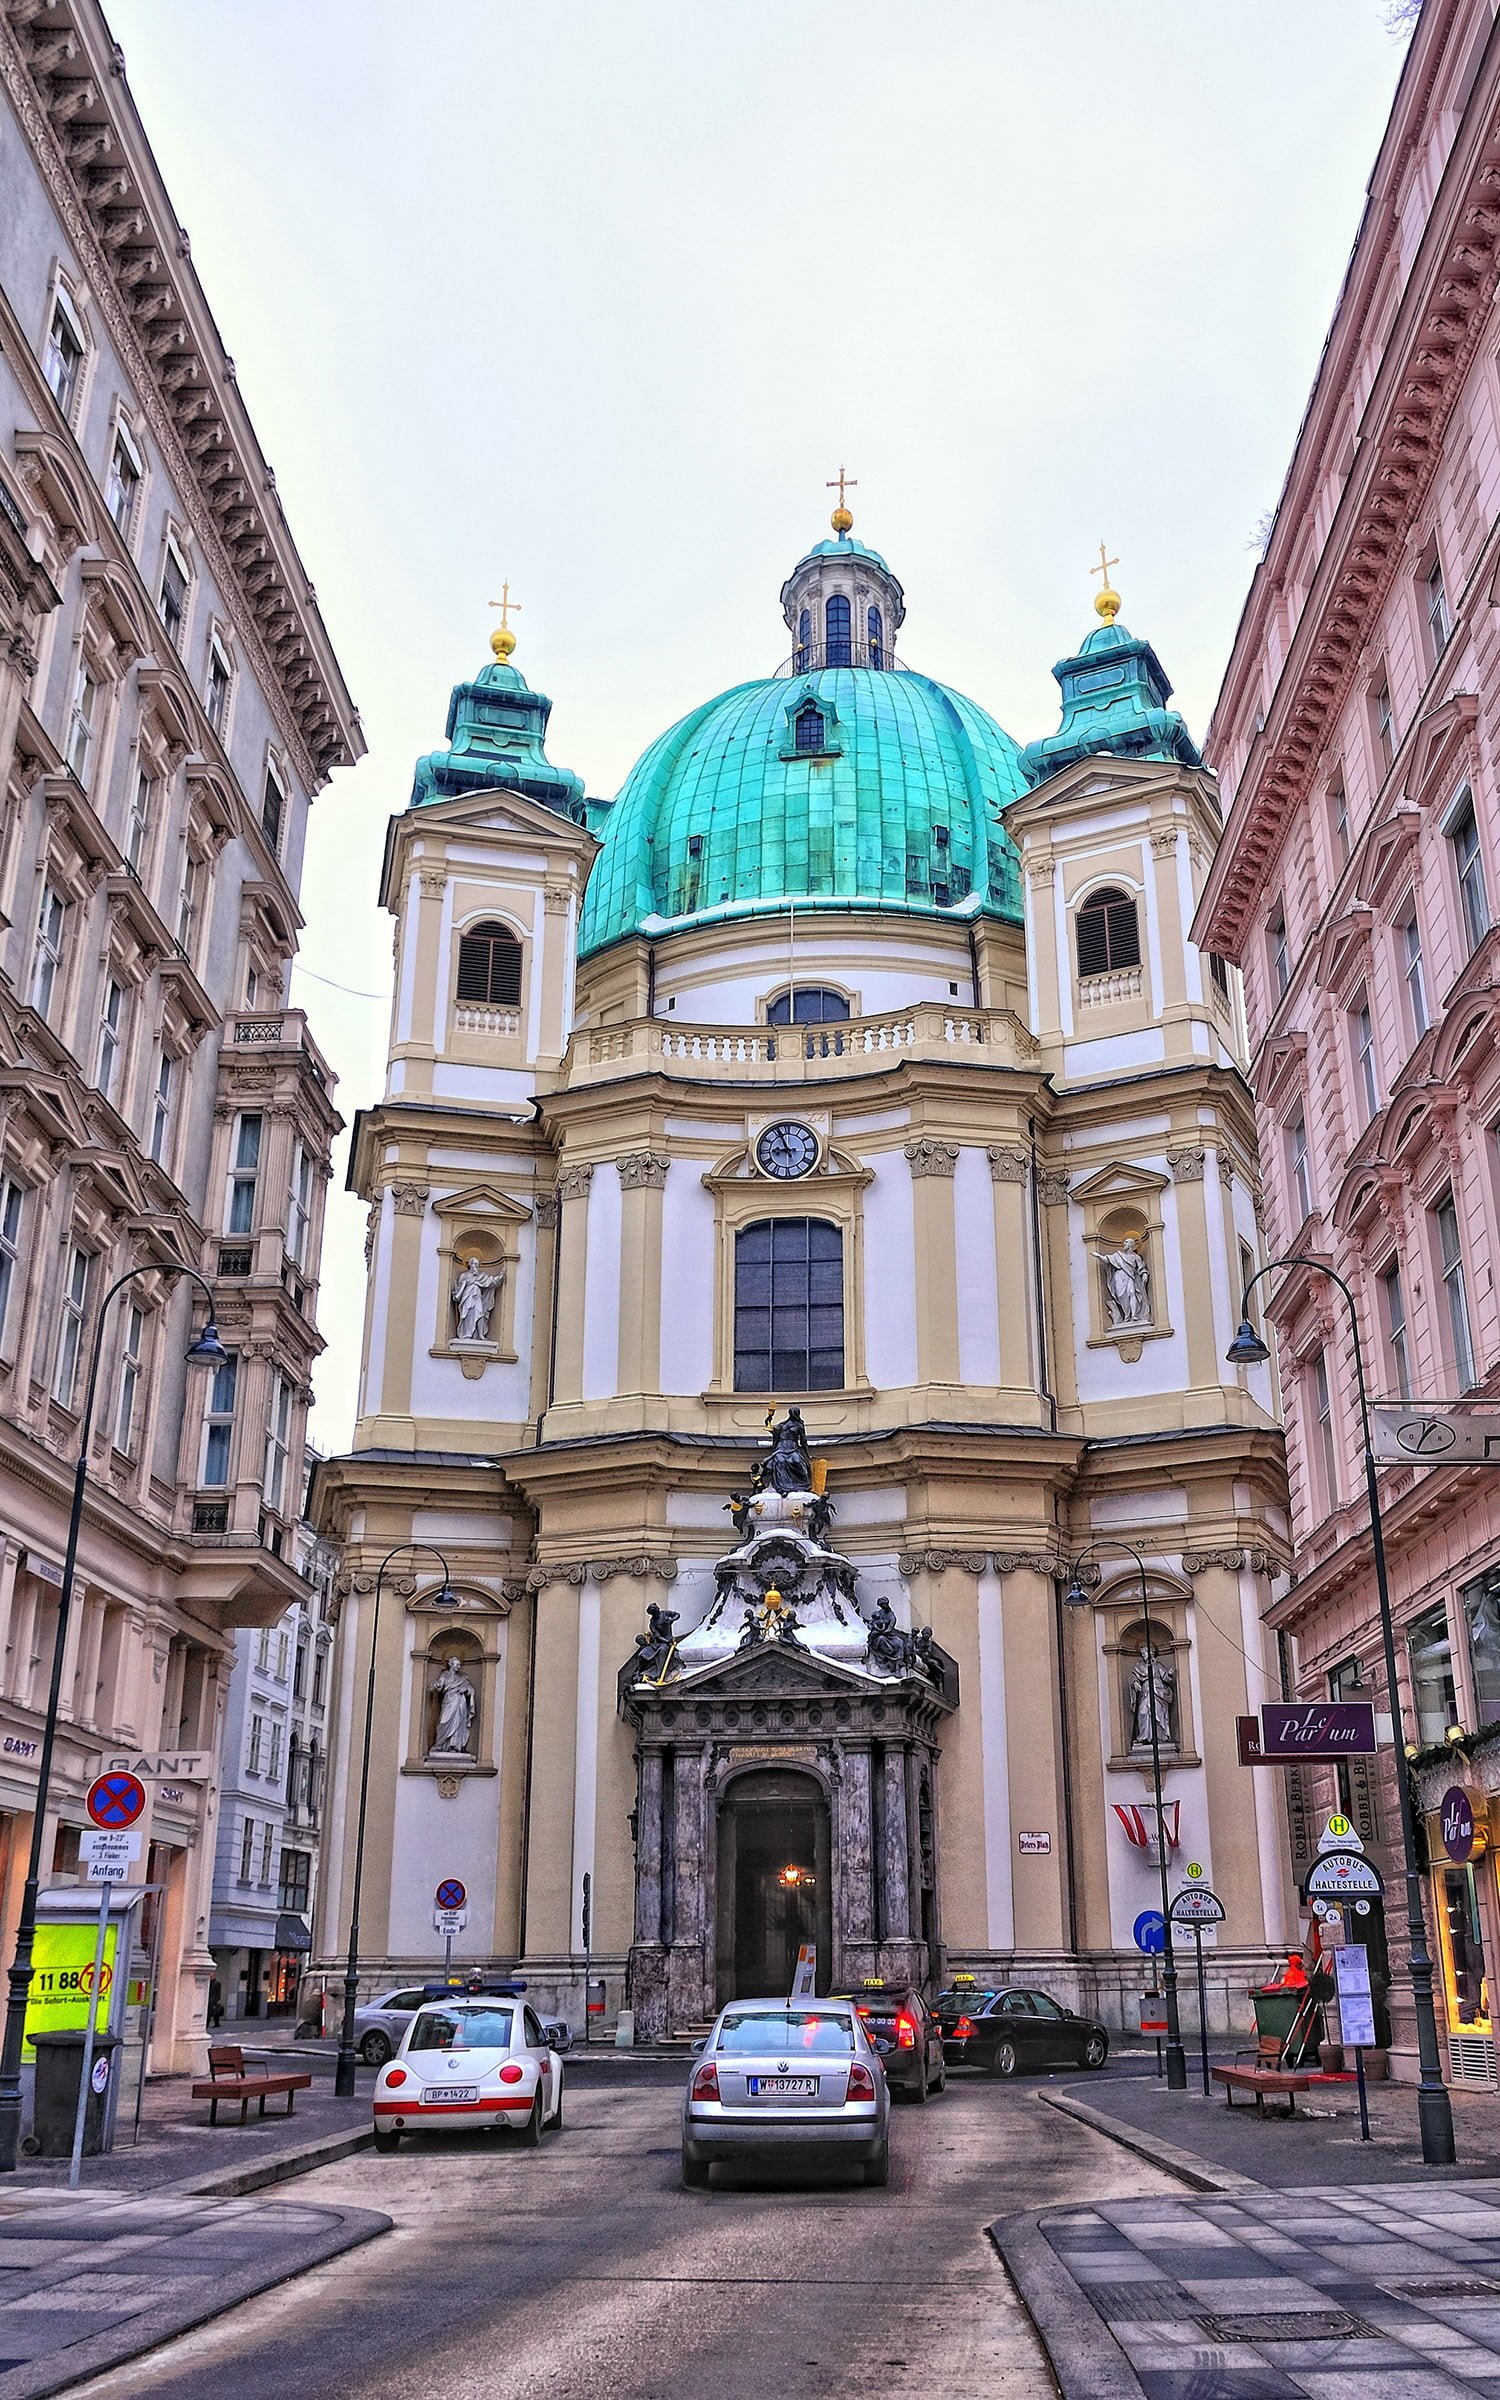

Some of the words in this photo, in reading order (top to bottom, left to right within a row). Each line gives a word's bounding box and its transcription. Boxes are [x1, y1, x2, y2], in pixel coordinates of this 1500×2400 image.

[1300, 1707, 1327, 1729] Le
[1279, 1707, 1360, 1750] Parfum
[4, 1737, 37, 1758] GANT
[109, 1758, 201, 1774] GANT
[92, 1864, 124, 1879] Anfang
[1322, 1857, 1365, 1873] AUTOBUS
[1315, 1880, 1373, 1889] HALTESTELLE
[1181, 1893, 1213, 1905] AUTOBUS
[1176, 1909, 1218, 1917] HALTESTELLE
[39, 1973, 54, 1991] 11
[59, 1971, 79, 1990] 88
